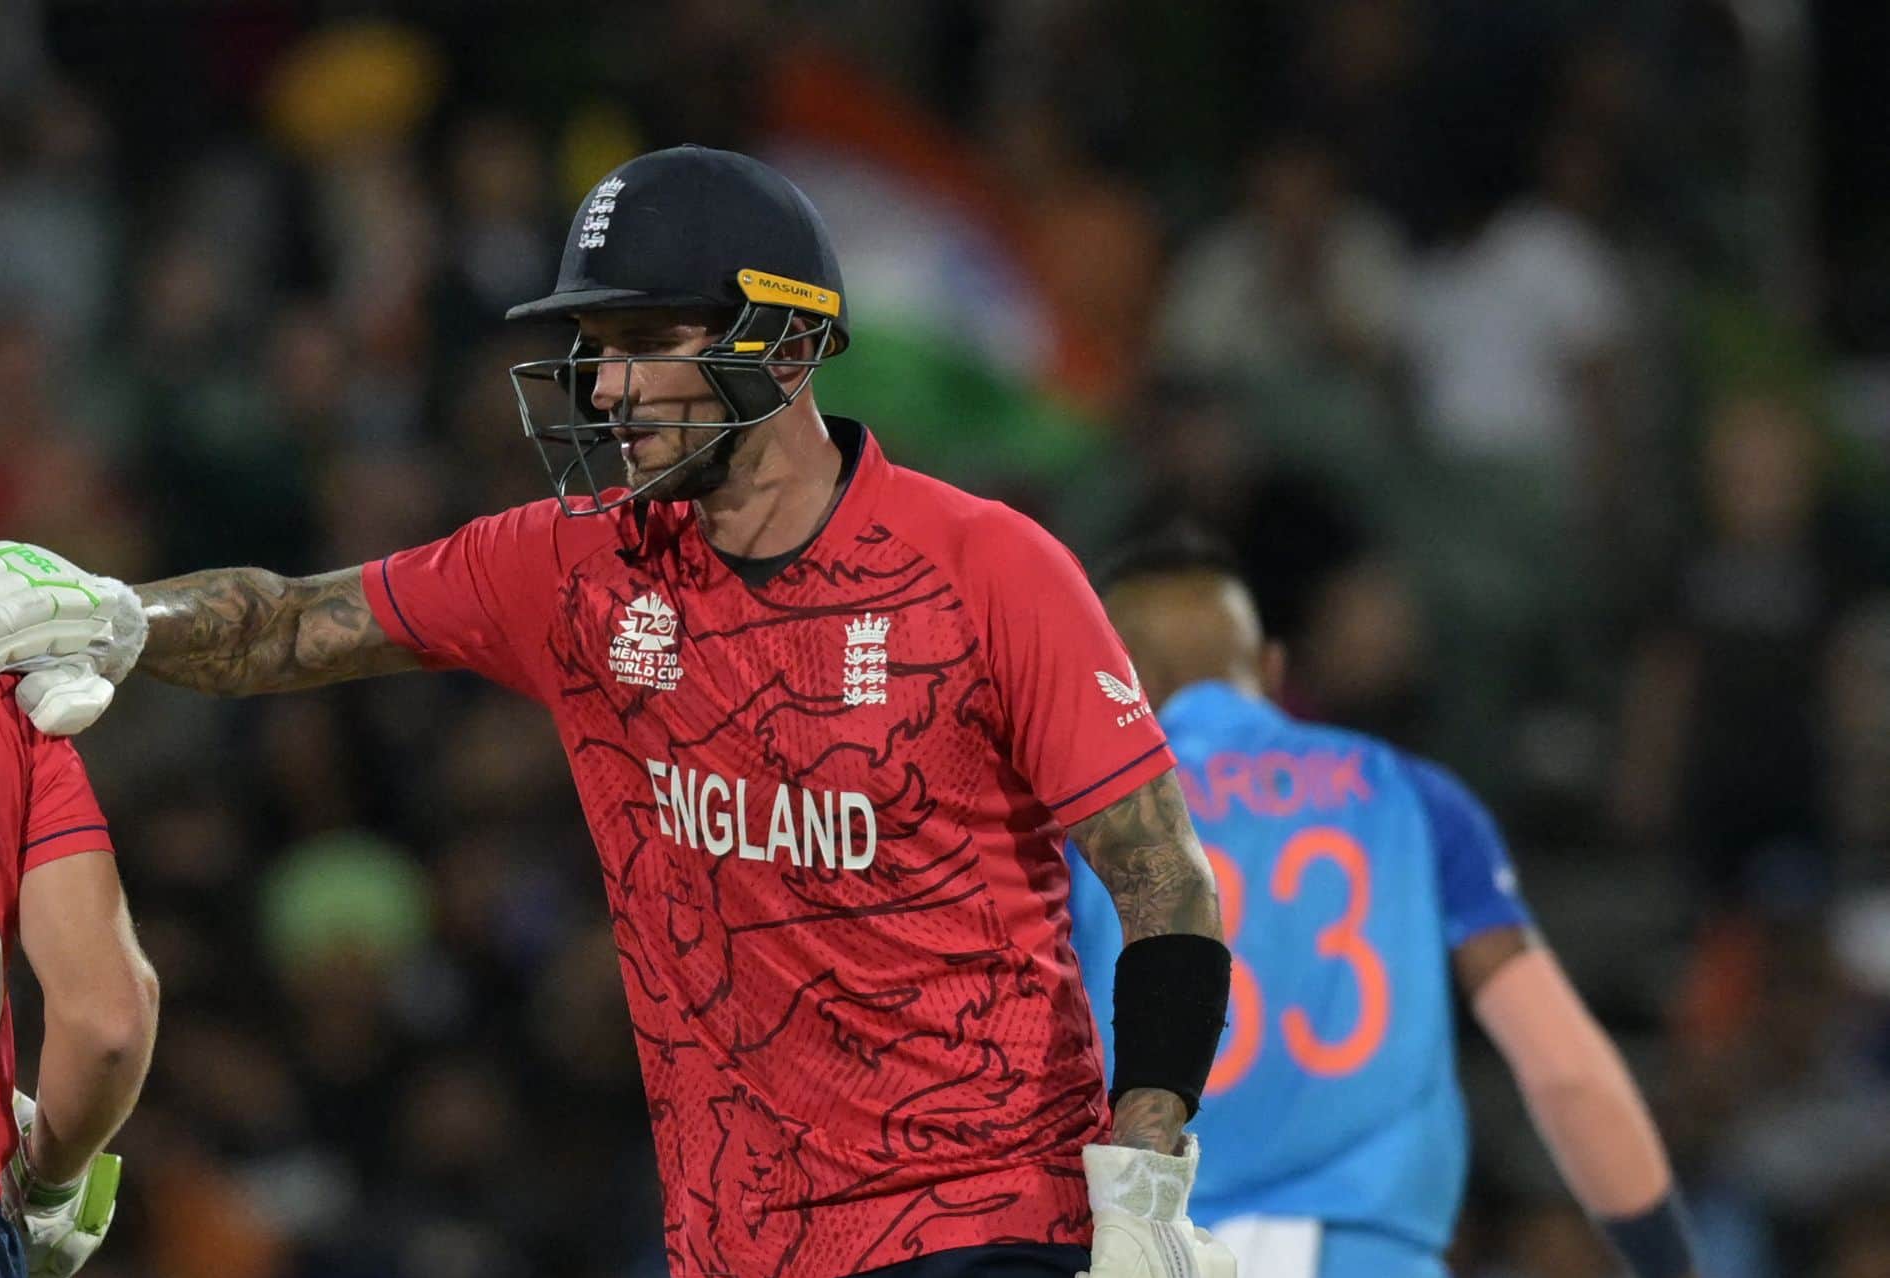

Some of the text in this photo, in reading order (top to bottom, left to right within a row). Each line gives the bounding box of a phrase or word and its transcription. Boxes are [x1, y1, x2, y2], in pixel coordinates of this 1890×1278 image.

[758, 278, 813, 299] MASURI
[609, 646, 678, 666] MEN'S T20
[608, 659, 684, 680] WORLD CUP
[646, 758, 877, 871] ENGLAND
